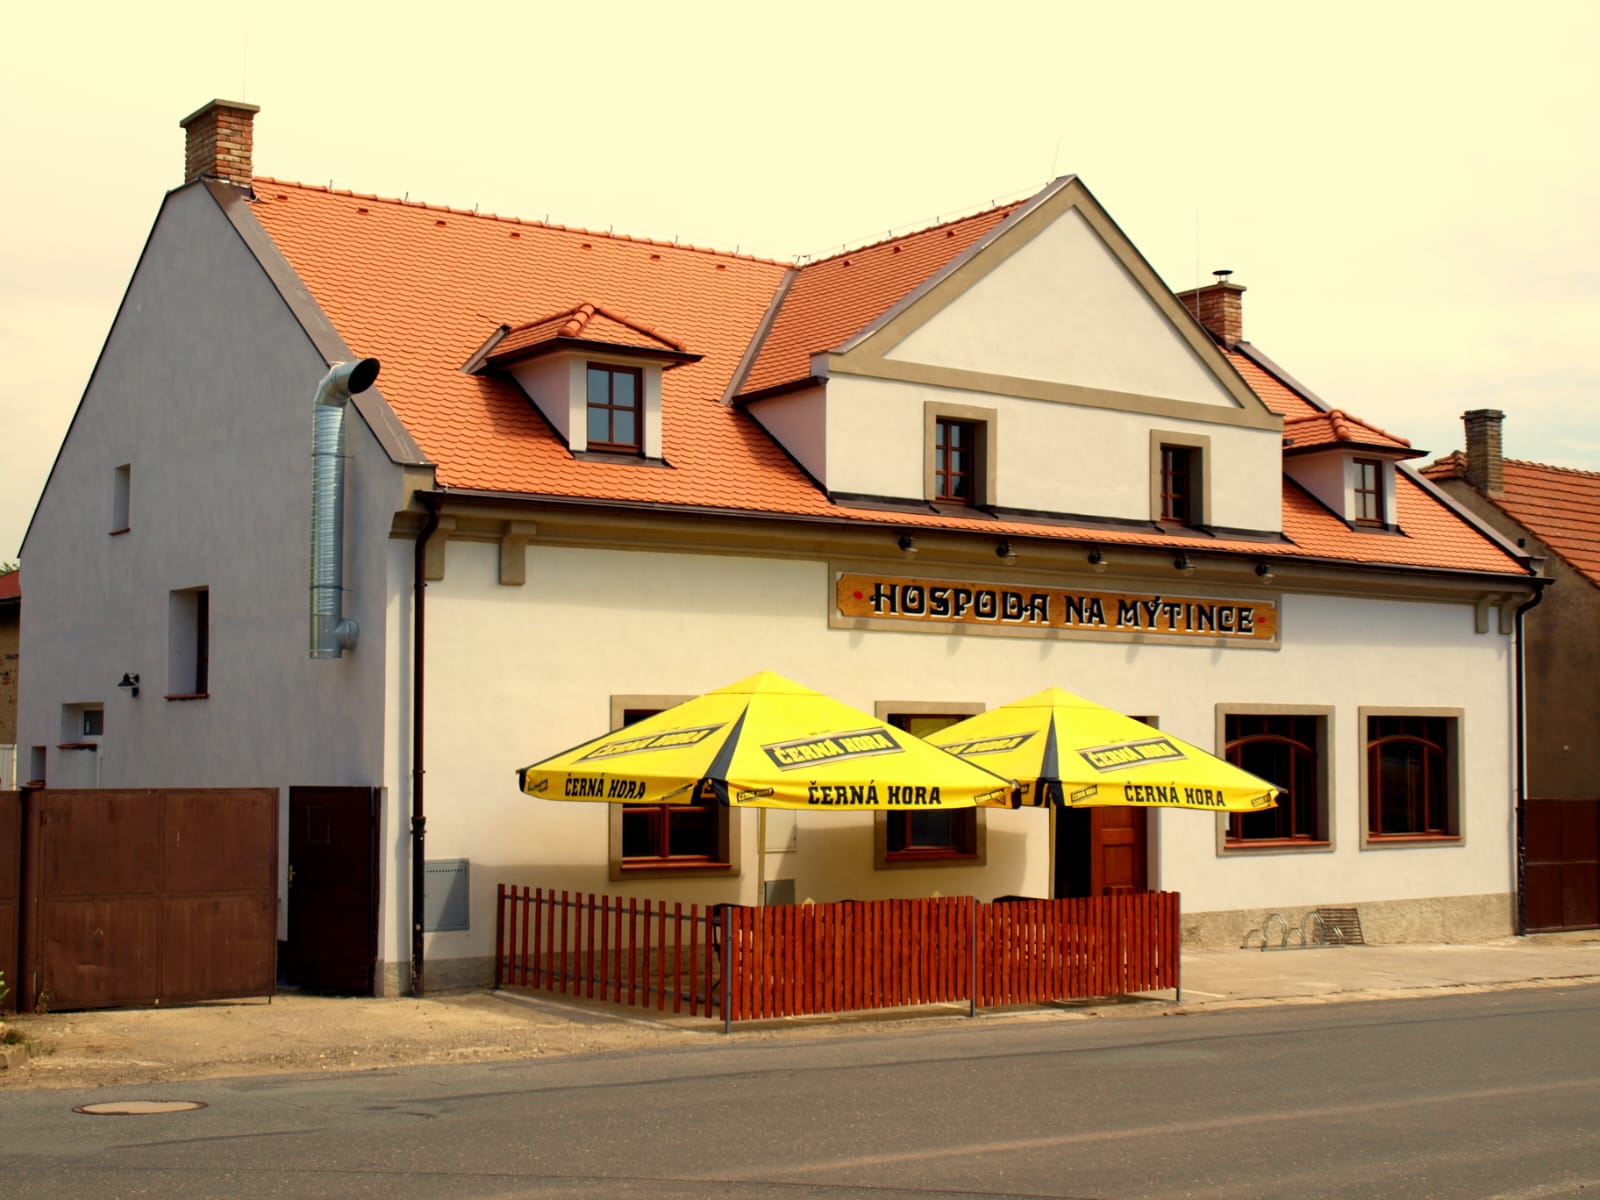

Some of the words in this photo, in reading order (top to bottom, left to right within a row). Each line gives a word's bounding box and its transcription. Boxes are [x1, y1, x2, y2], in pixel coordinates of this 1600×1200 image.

[870, 583, 1050, 624] HOSPODA
[1064, 595, 1107, 627] NA
[1116, 595, 1255, 635] MÝTINCE
[772, 739, 844, 765] ČERNÁ
[837, 733, 894, 752] HORA
[564, 773, 605, 797] ČERNÁ
[607, 779, 646, 799] HORA
[808, 779, 879, 805] ČERNÁ
[887, 785, 942, 805] HORA
[1124, 780, 1180, 804] ČERNÁ
[1184, 787, 1227, 807] HORA
